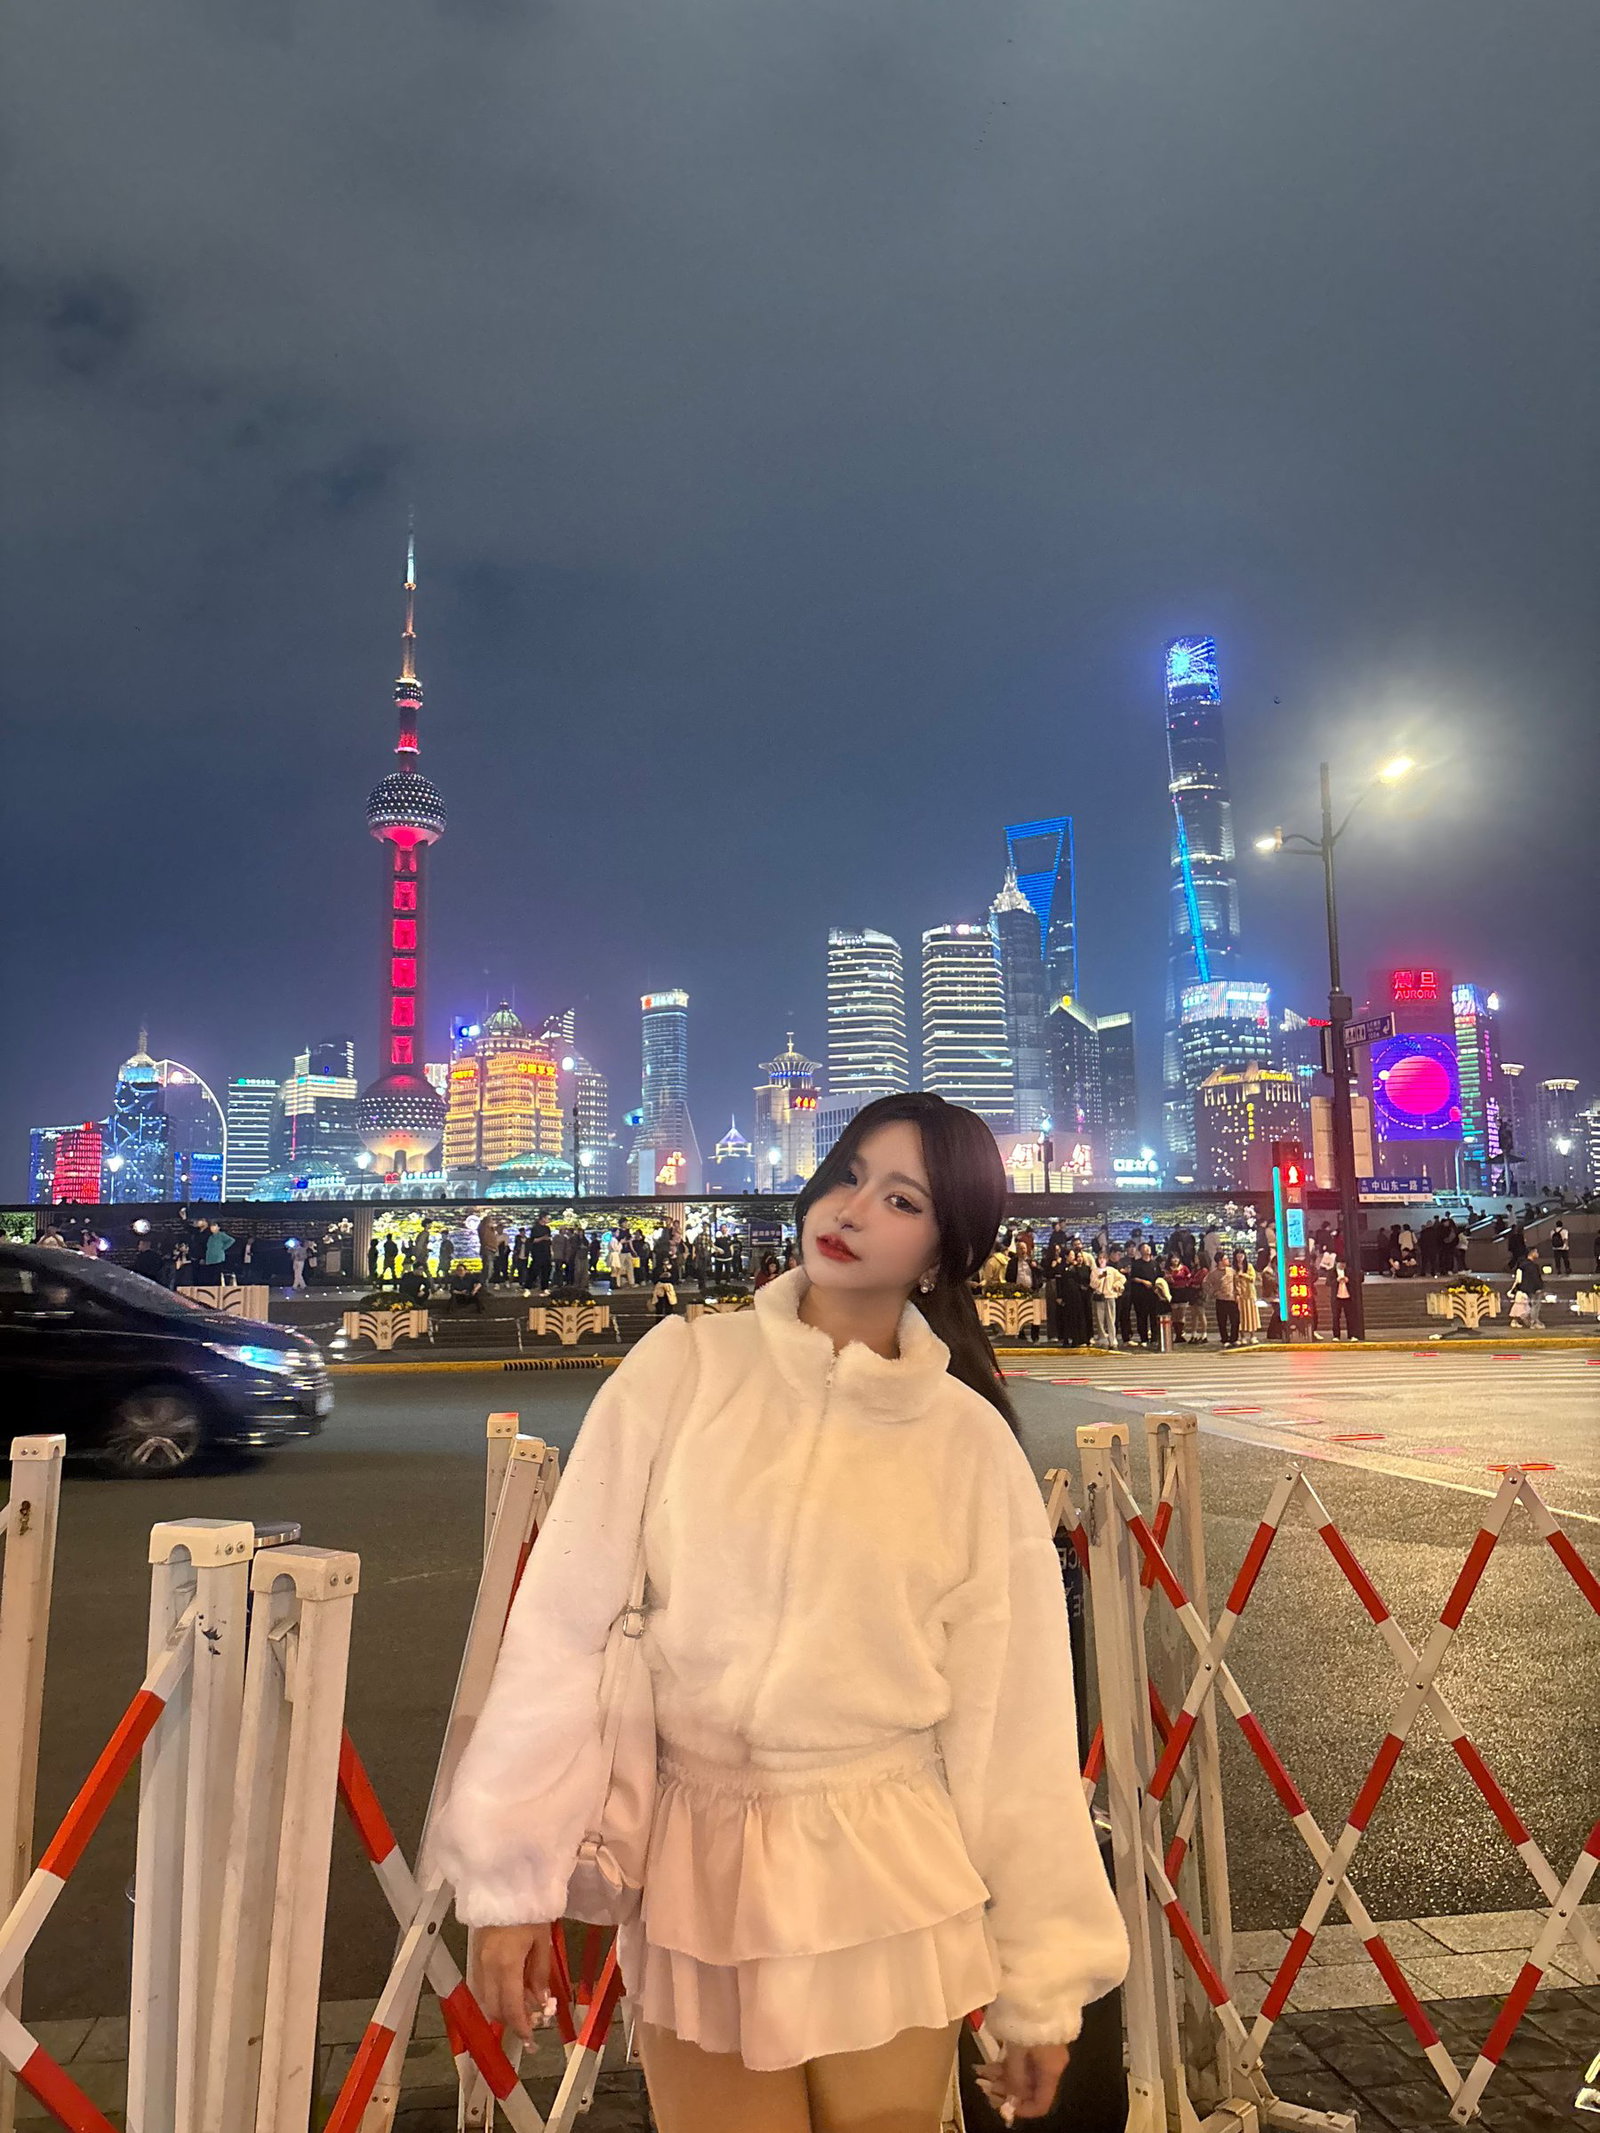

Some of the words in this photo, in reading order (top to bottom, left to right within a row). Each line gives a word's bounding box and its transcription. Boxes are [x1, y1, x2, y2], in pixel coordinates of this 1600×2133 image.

[1394, 971, 1436, 988] 震旦
[1394, 989, 1437, 999] AURORA
[1371, 1180, 1418, 1192] 中山东一路
